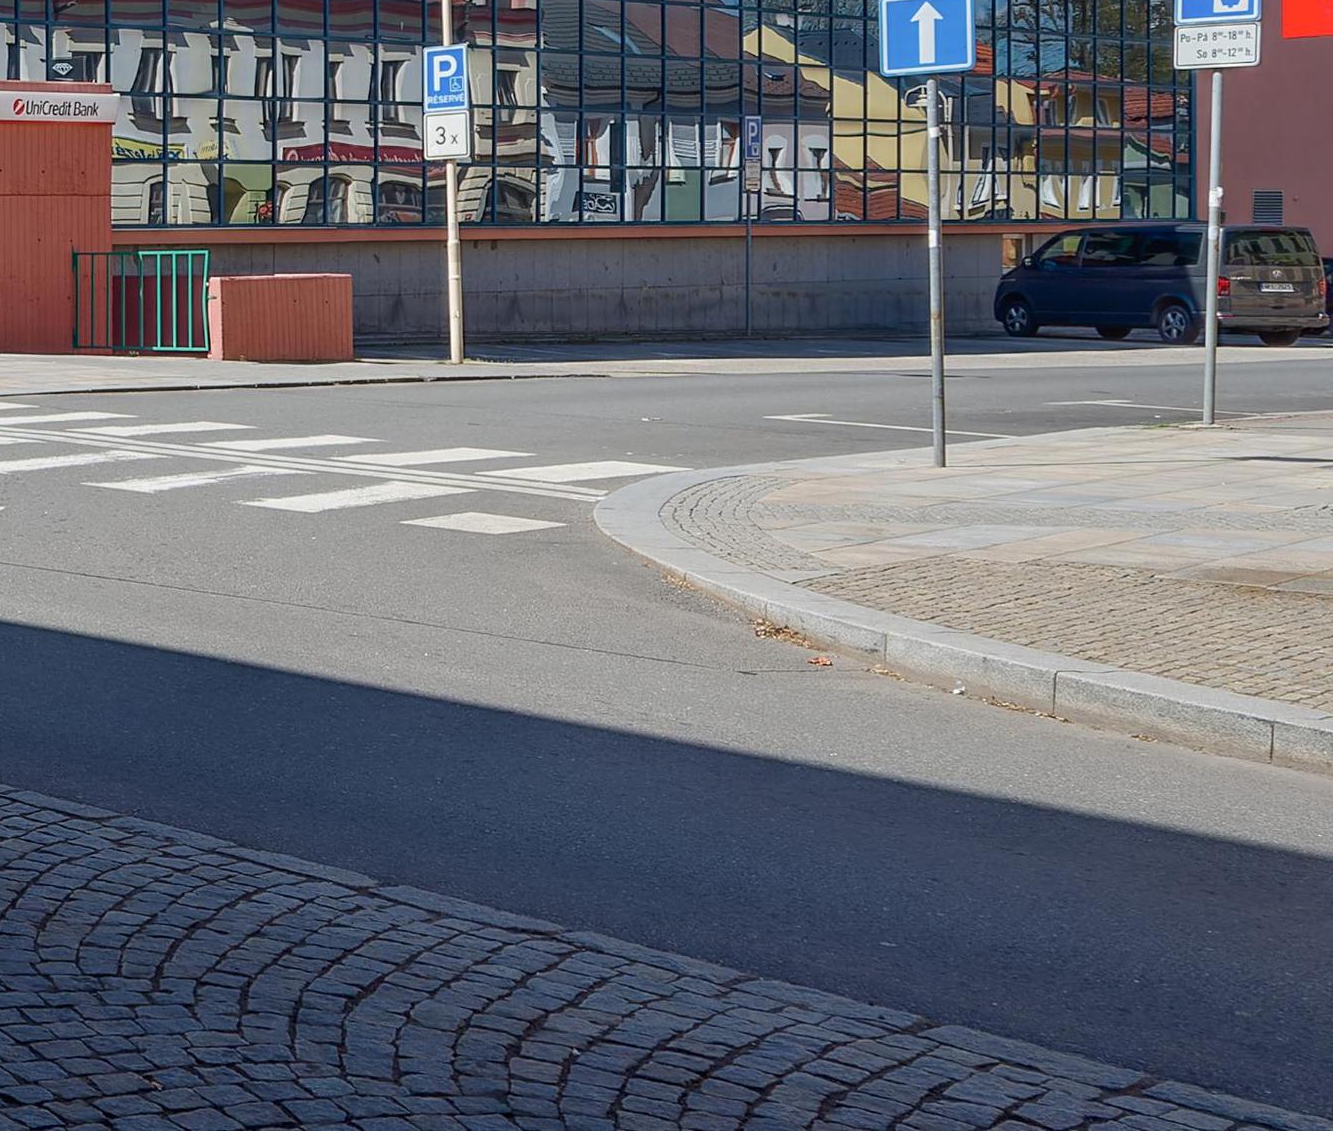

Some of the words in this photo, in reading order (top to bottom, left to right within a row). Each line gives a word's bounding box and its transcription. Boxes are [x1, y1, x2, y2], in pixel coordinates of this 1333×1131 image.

[1196, 49, 1208, 60] So
[433, 54, 458, 92] P
[26, 100, 71, 116] UniCredit
[73, 101, 99, 117] Bank
